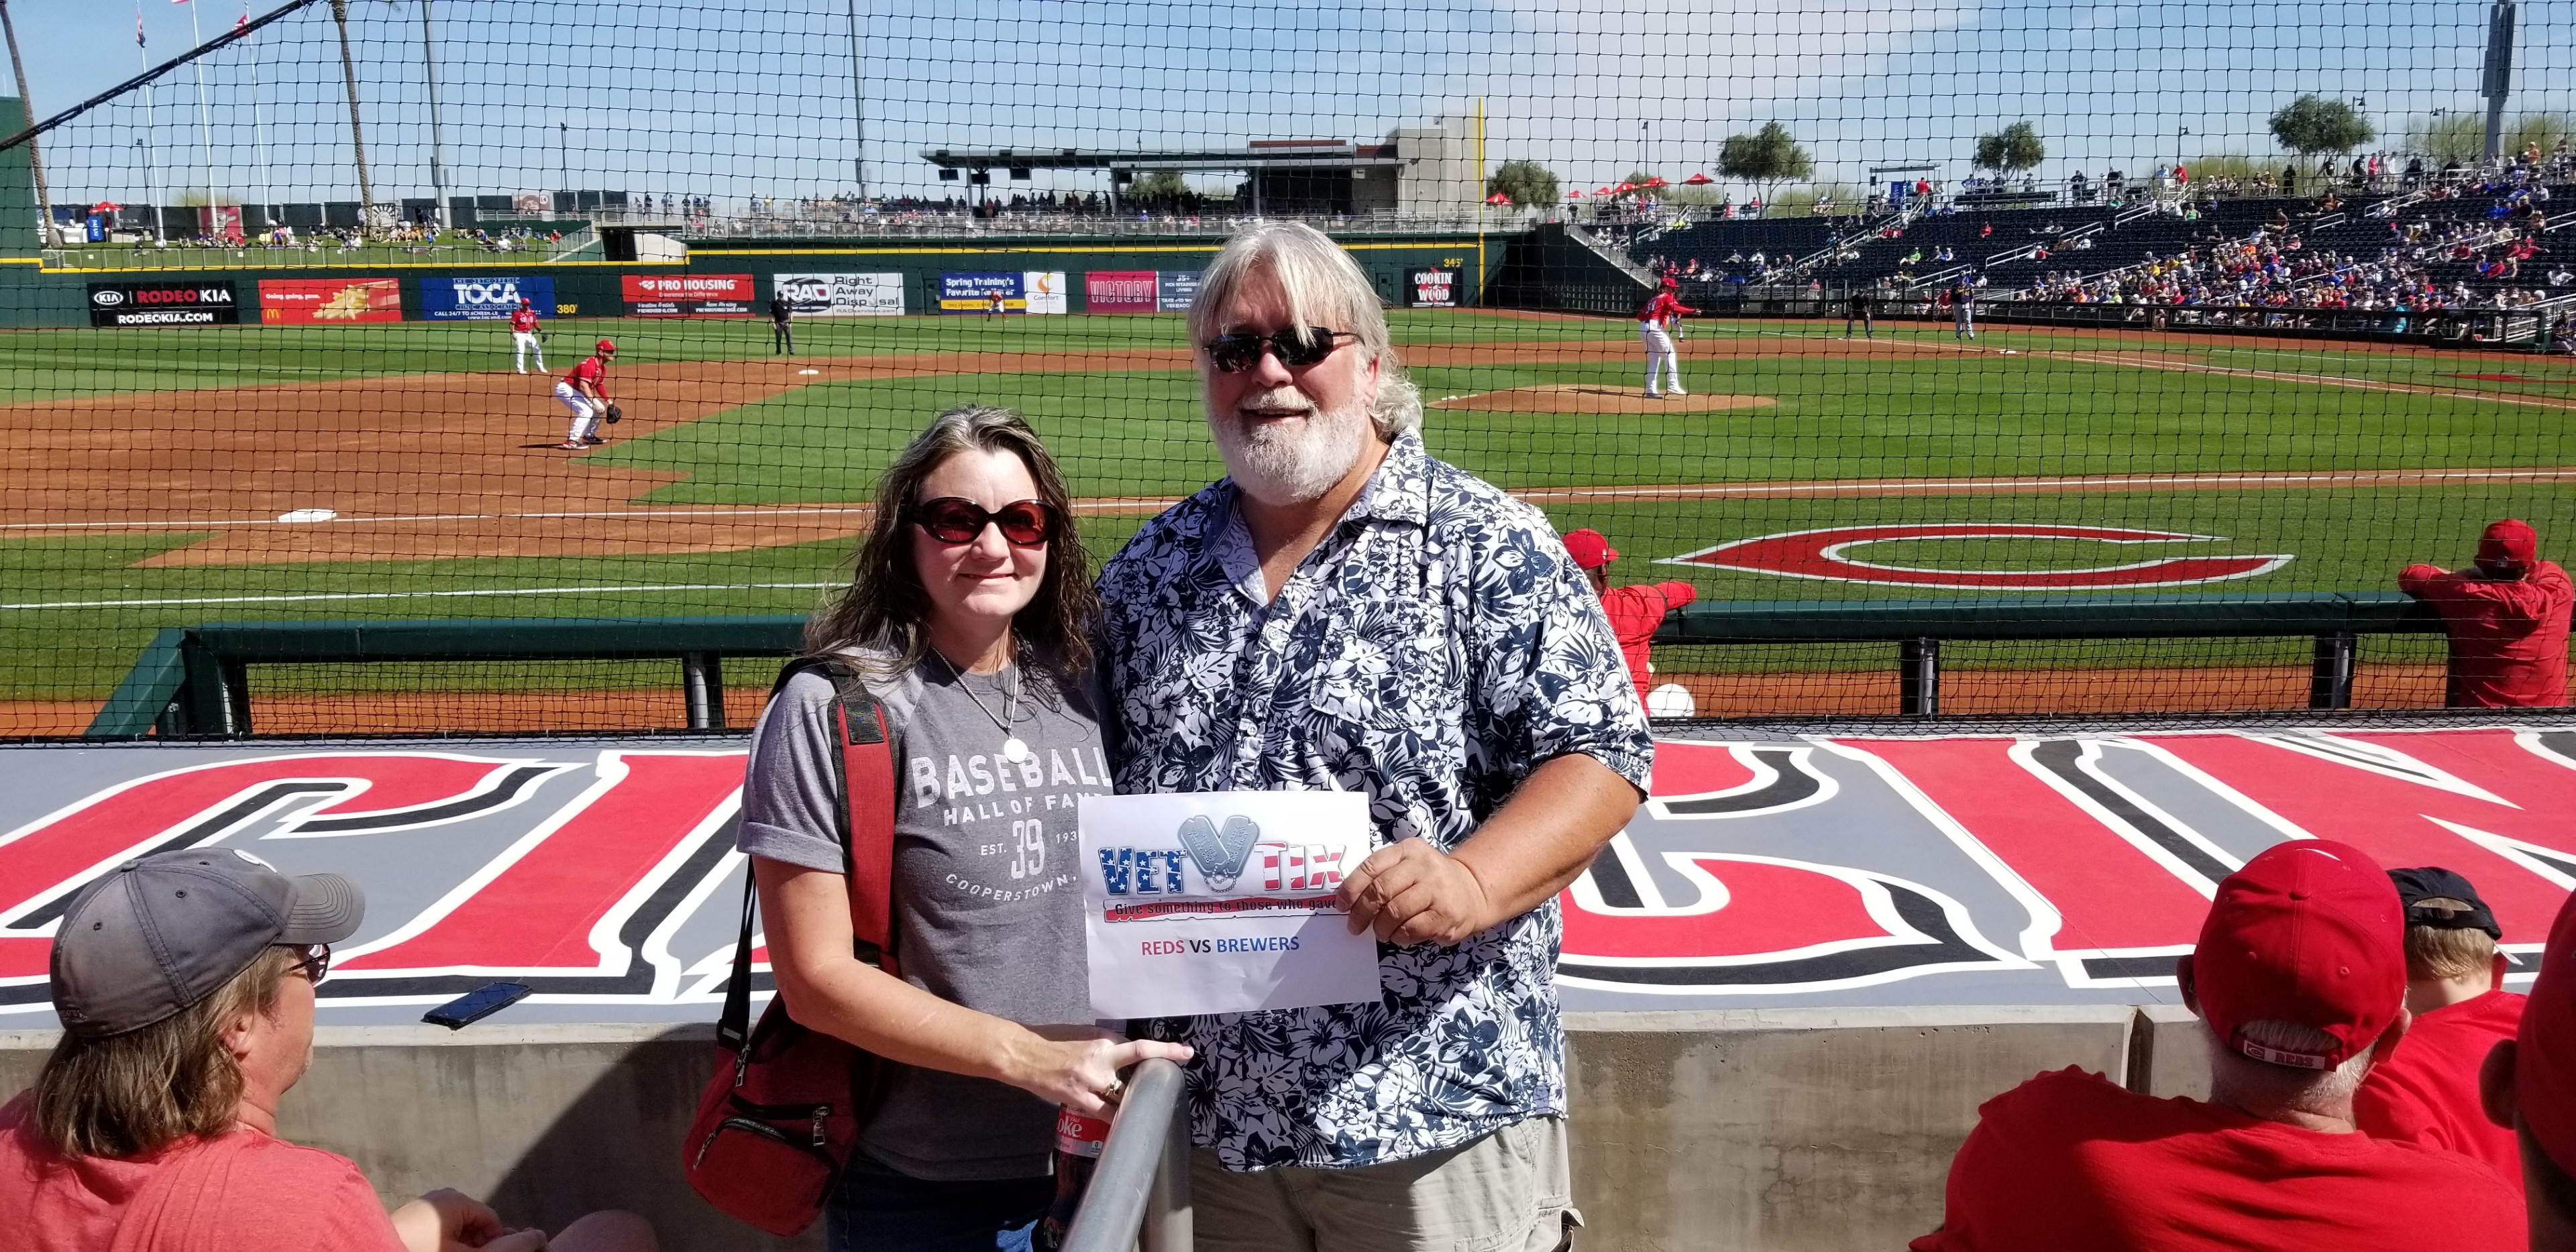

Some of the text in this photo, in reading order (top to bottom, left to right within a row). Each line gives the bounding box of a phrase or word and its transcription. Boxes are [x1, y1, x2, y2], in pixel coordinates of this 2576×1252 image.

[658, 279, 735, 290] PRO HOUSING
[835, 276, 873, 286] Right
[946, 277, 1014, 287] Spring Training's
[136, 289, 231, 304] RODEO KIA
[453, 283, 521, 304] TOCA
[782, 284, 831, 302] RAD
[836, 287, 873, 297] Away
[1090, 281, 1153, 303] VICTORY
[1417, 289, 1449, 301] WOOD
[557, 303, 578, 314] 380'
[118, 313, 213, 324] RODEOKIA.COM
[911, 747, 1114, 808] BASEBALL
[944, 801, 1004, 827] HALL
[1010, 797, 1032, 814] OF
[981, 843, 1007, 856] EST.
[1011, 819, 1045, 879] 39
[1097, 847, 1189, 895] VET
[1253, 842, 1346, 891] TIX
[946, 873, 1077, 902] COOPERSTOWN,
[1115, 904, 1143, 915] Give
[1147, 901, 1214, 914] something
[1219, 902, 1232, 911] to
[1236, 900, 1272, 911] those
[1276, 899, 1303, 910] who
[1142, 936, 1300, 956] REDS VS BREWERS
[2275, 1051, 2314, 1067] REDS
